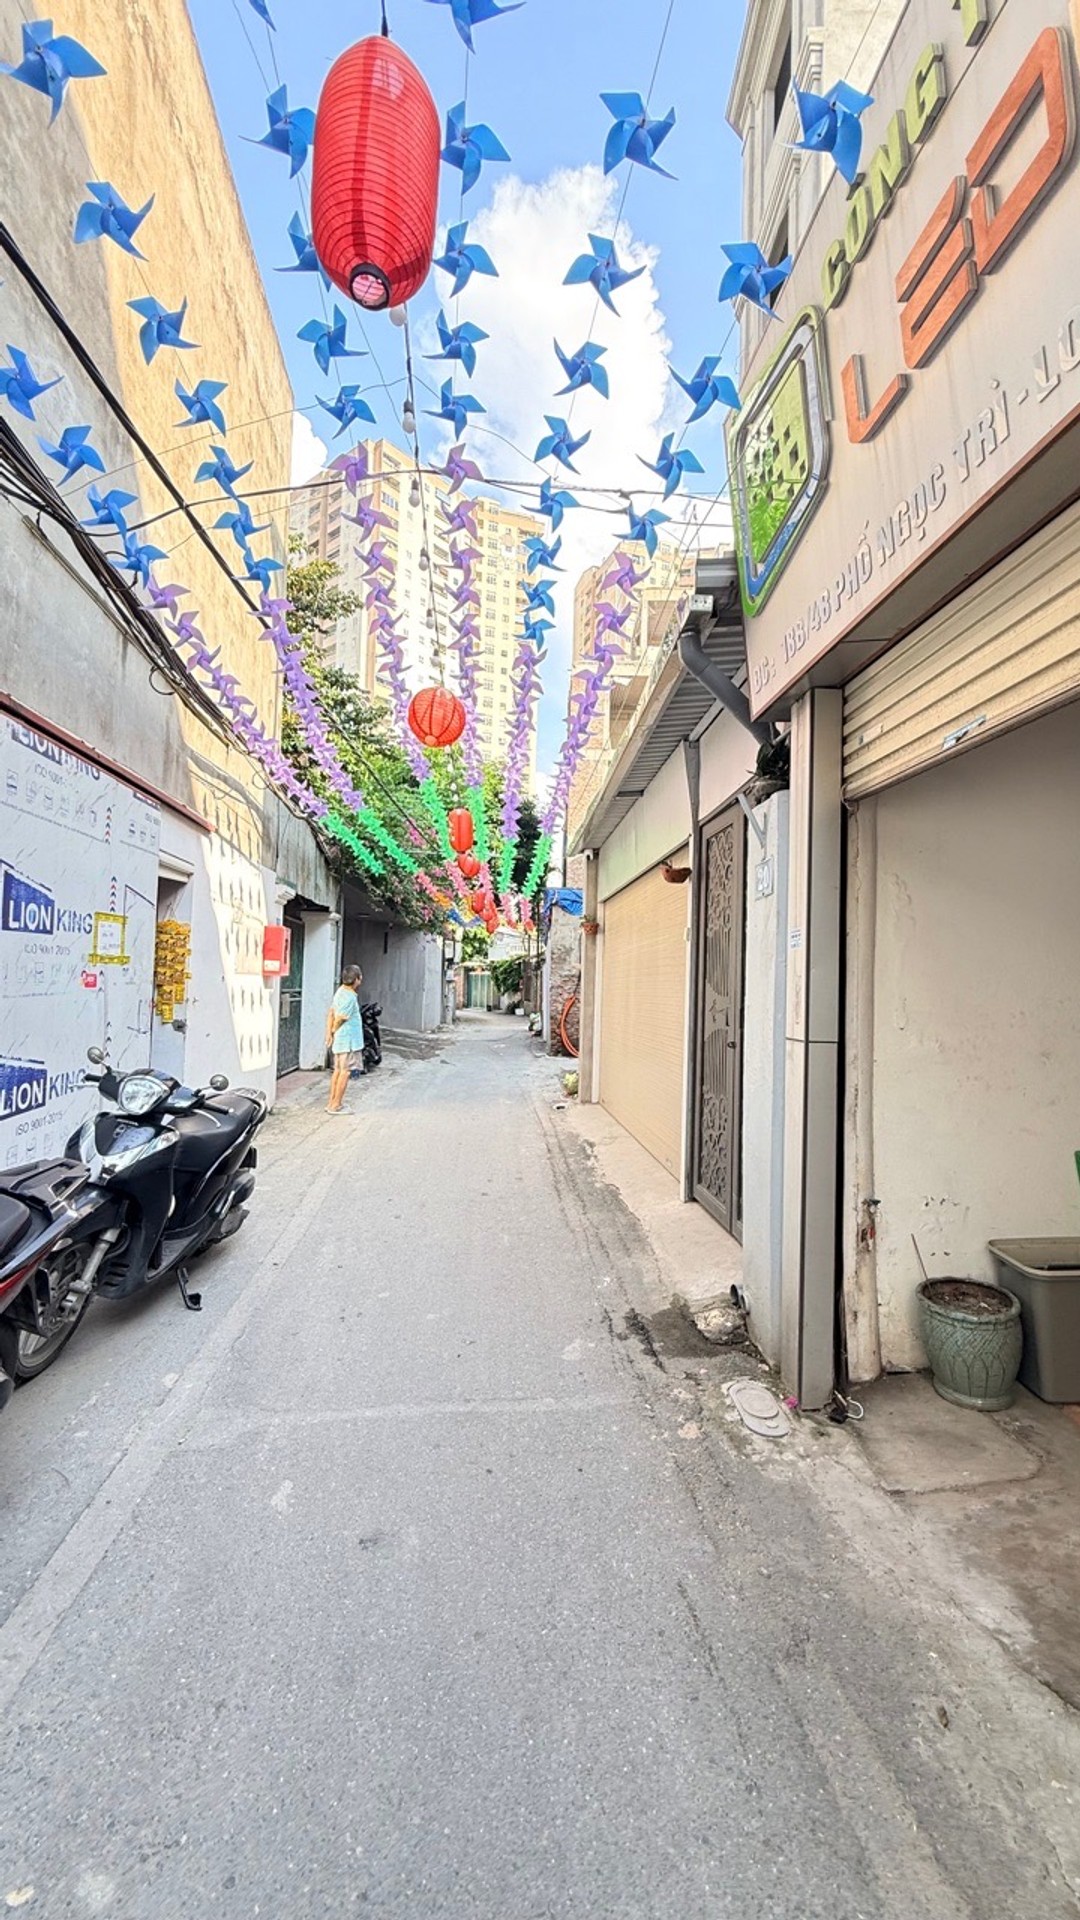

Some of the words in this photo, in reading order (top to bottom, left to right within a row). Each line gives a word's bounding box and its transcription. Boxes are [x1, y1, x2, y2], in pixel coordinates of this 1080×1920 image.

[821, 42, 947, 309] CÔNG
[835, 519, 873, 612] PHỐ
[877, 463, 946, 567] NGỌC
[953, 377, 1010, 483] TRÌ
[9, 899, 52, 931] LION
[56, 908, 93, 935] KING
[0, 1078, 44, 1117] LION
